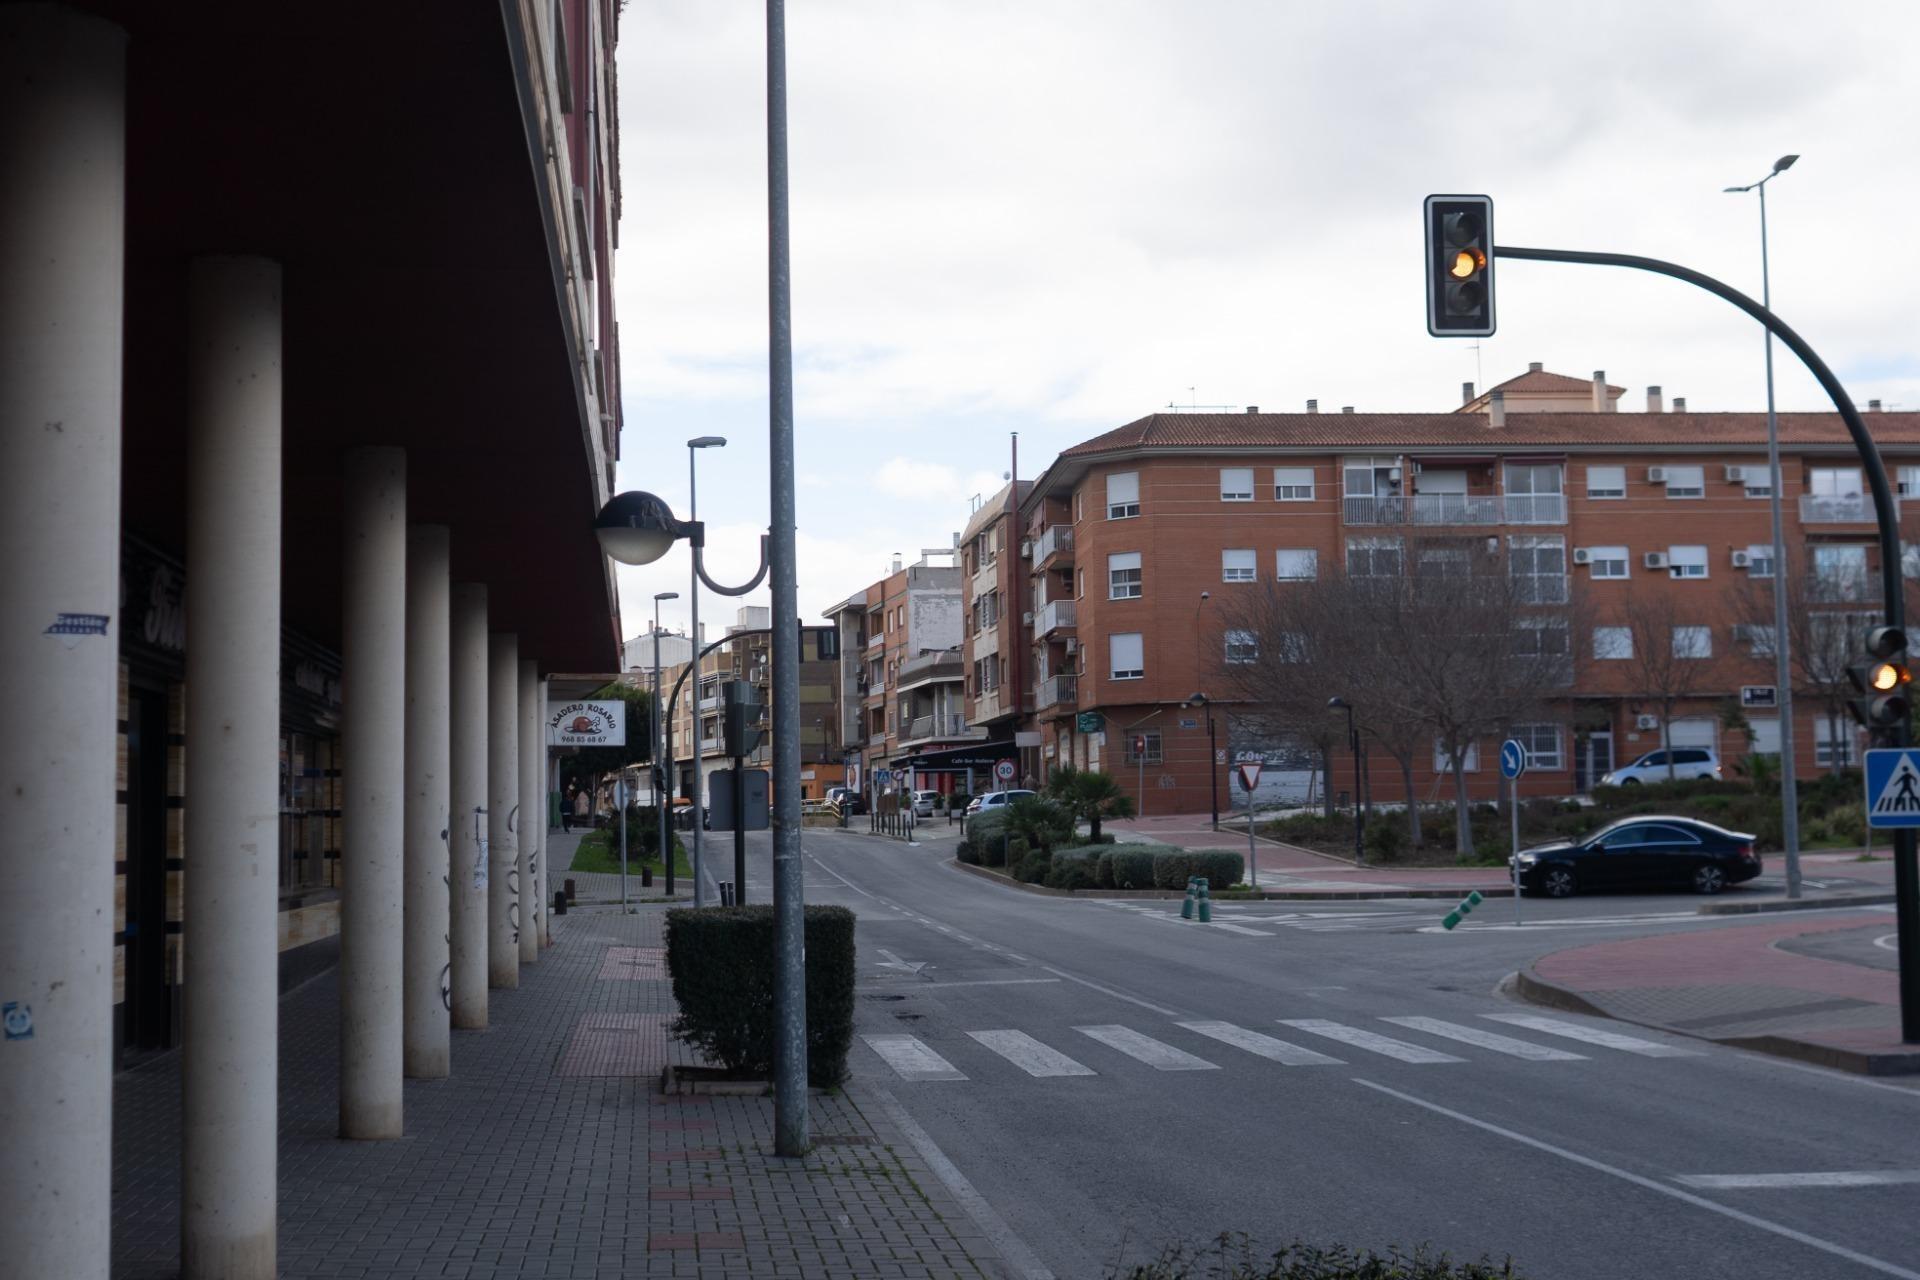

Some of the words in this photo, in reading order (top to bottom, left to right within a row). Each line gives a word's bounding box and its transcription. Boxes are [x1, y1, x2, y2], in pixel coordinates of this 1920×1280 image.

[551, 703, 584, 728] ASADERO
[587, 703, 616, 729] ROSARIO
[1000, 766, 1012, 775] 30
